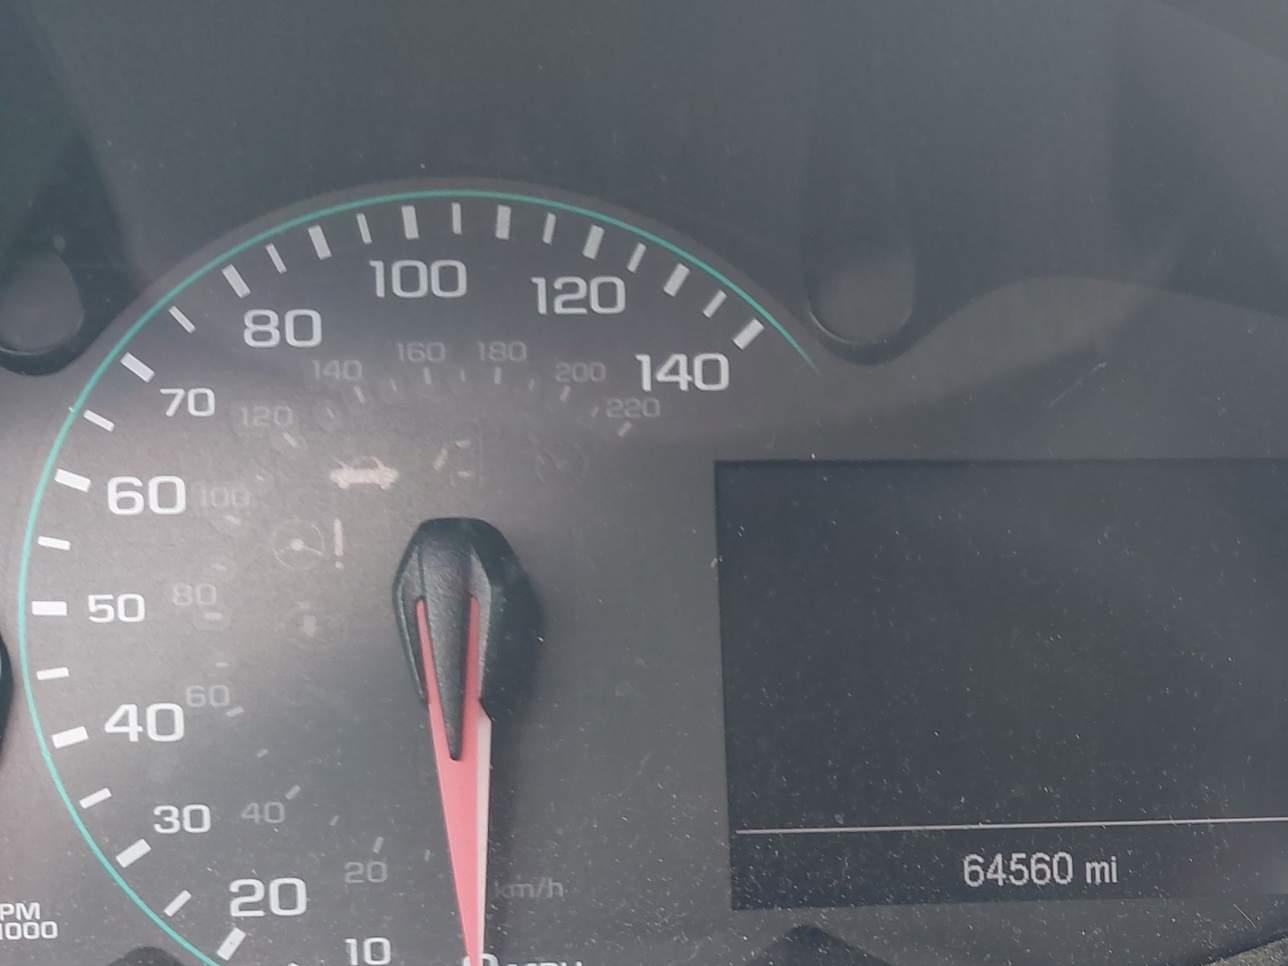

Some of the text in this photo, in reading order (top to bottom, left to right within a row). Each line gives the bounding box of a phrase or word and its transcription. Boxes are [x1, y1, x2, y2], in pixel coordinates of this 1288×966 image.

[369, 260, 467, 298] 100
[530, 275, 626, 315] 120
[243, 309, 322, 348] 80
[397, 341, 445, 362] 160
[478, 341, 527, 362] 180
[312, 360, 362, 380] 140
[555, 362, 606, 382] 200
[635, 352, 730, 391] 140
[160, 388, 215, 416] 70
[606, 398, 660, 418] 220
[240, 407, 294, 427] 120
[107, 476, 186, 515] 60
[200, 485, 250, 506] 100
[171, 584, 216, 605] 80
[88, 594, 145, 623] 50
[185, 685, 230, 708] 60
[104, 703, 185, 742] 40
[153, 805, 211, 833] 30
[241, 802, 286, 825] 40
[344, 862, 387, 883] 20
[963, 852, 1118, 887] 64560 mi
[229, 877, 308, 917] 20
[496, 878, 564, 899] km/h
[0, 903, 40, 919] PM
[344, 937, 391, 966] 10
